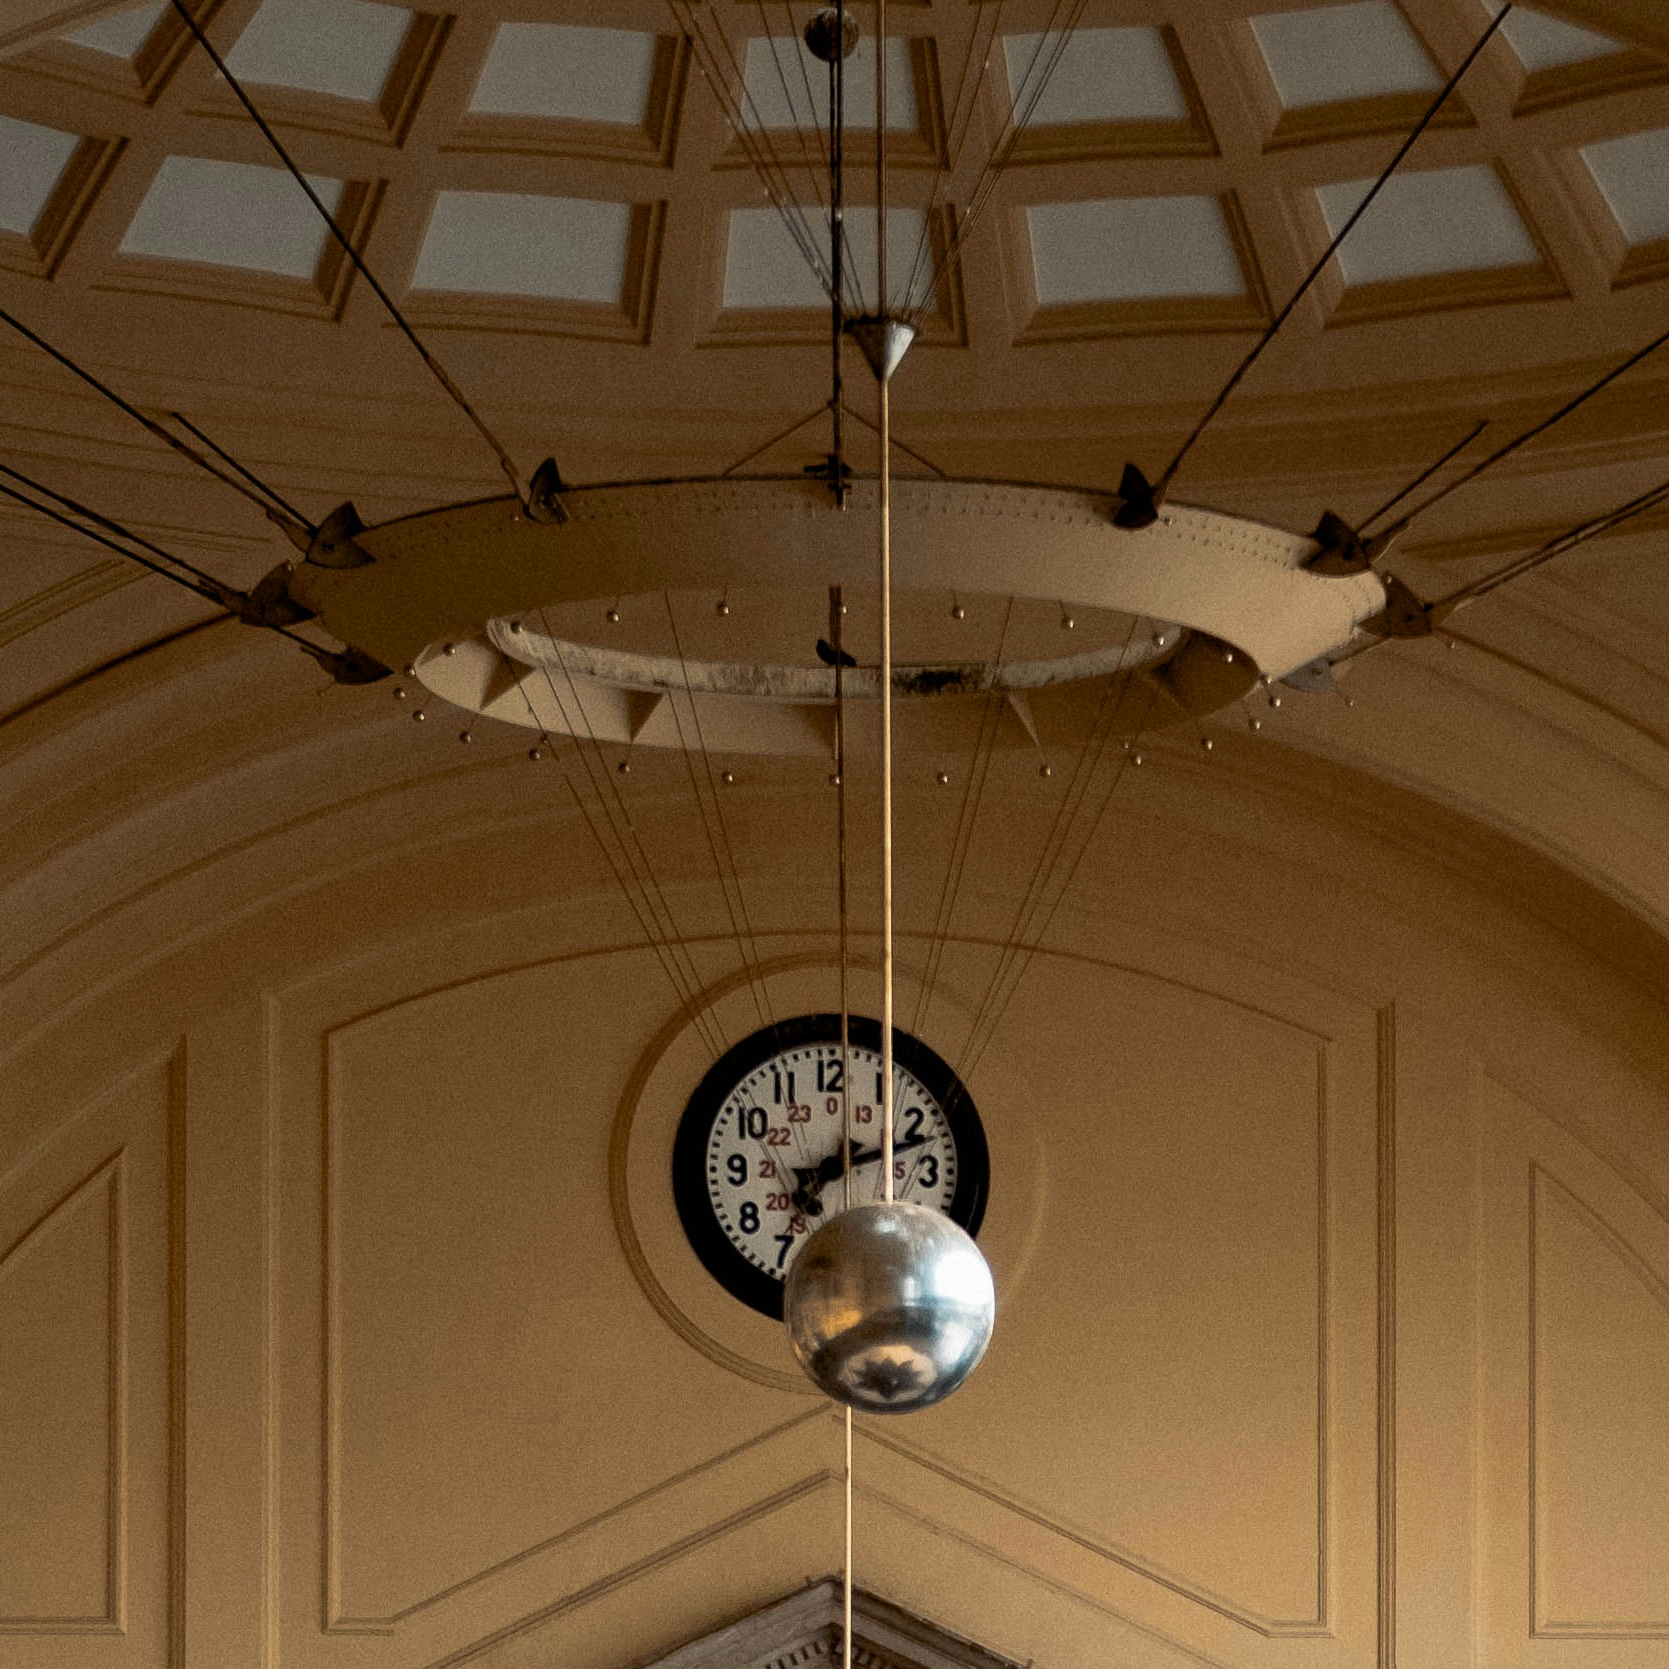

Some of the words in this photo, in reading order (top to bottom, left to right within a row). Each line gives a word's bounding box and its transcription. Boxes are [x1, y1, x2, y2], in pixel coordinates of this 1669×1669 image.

[774, 1071, 796, 1104] 11
[817, 1059, 844, 1093] 12
[876, 1072, 884, 1104] 1
[788, 1104, 811, 1123] 23
[826, 1097, 838, 1115] 0
[854, 1106, 873, 1124] 13
[737, 1107, 768, 1140] 10
[768, 1128, 792, 1146] 22
[905, 1107, 926, 1142] 2
[727, 1154, 748, 1187] 9
[759, 1161, 777, 1179] 21
[918, 1156, 939, 1188] 3
[739, 1201, 760, 1235] 8
[766, 1194, 790, 1212] 20
[774, 1235, 795, 1268] 7
